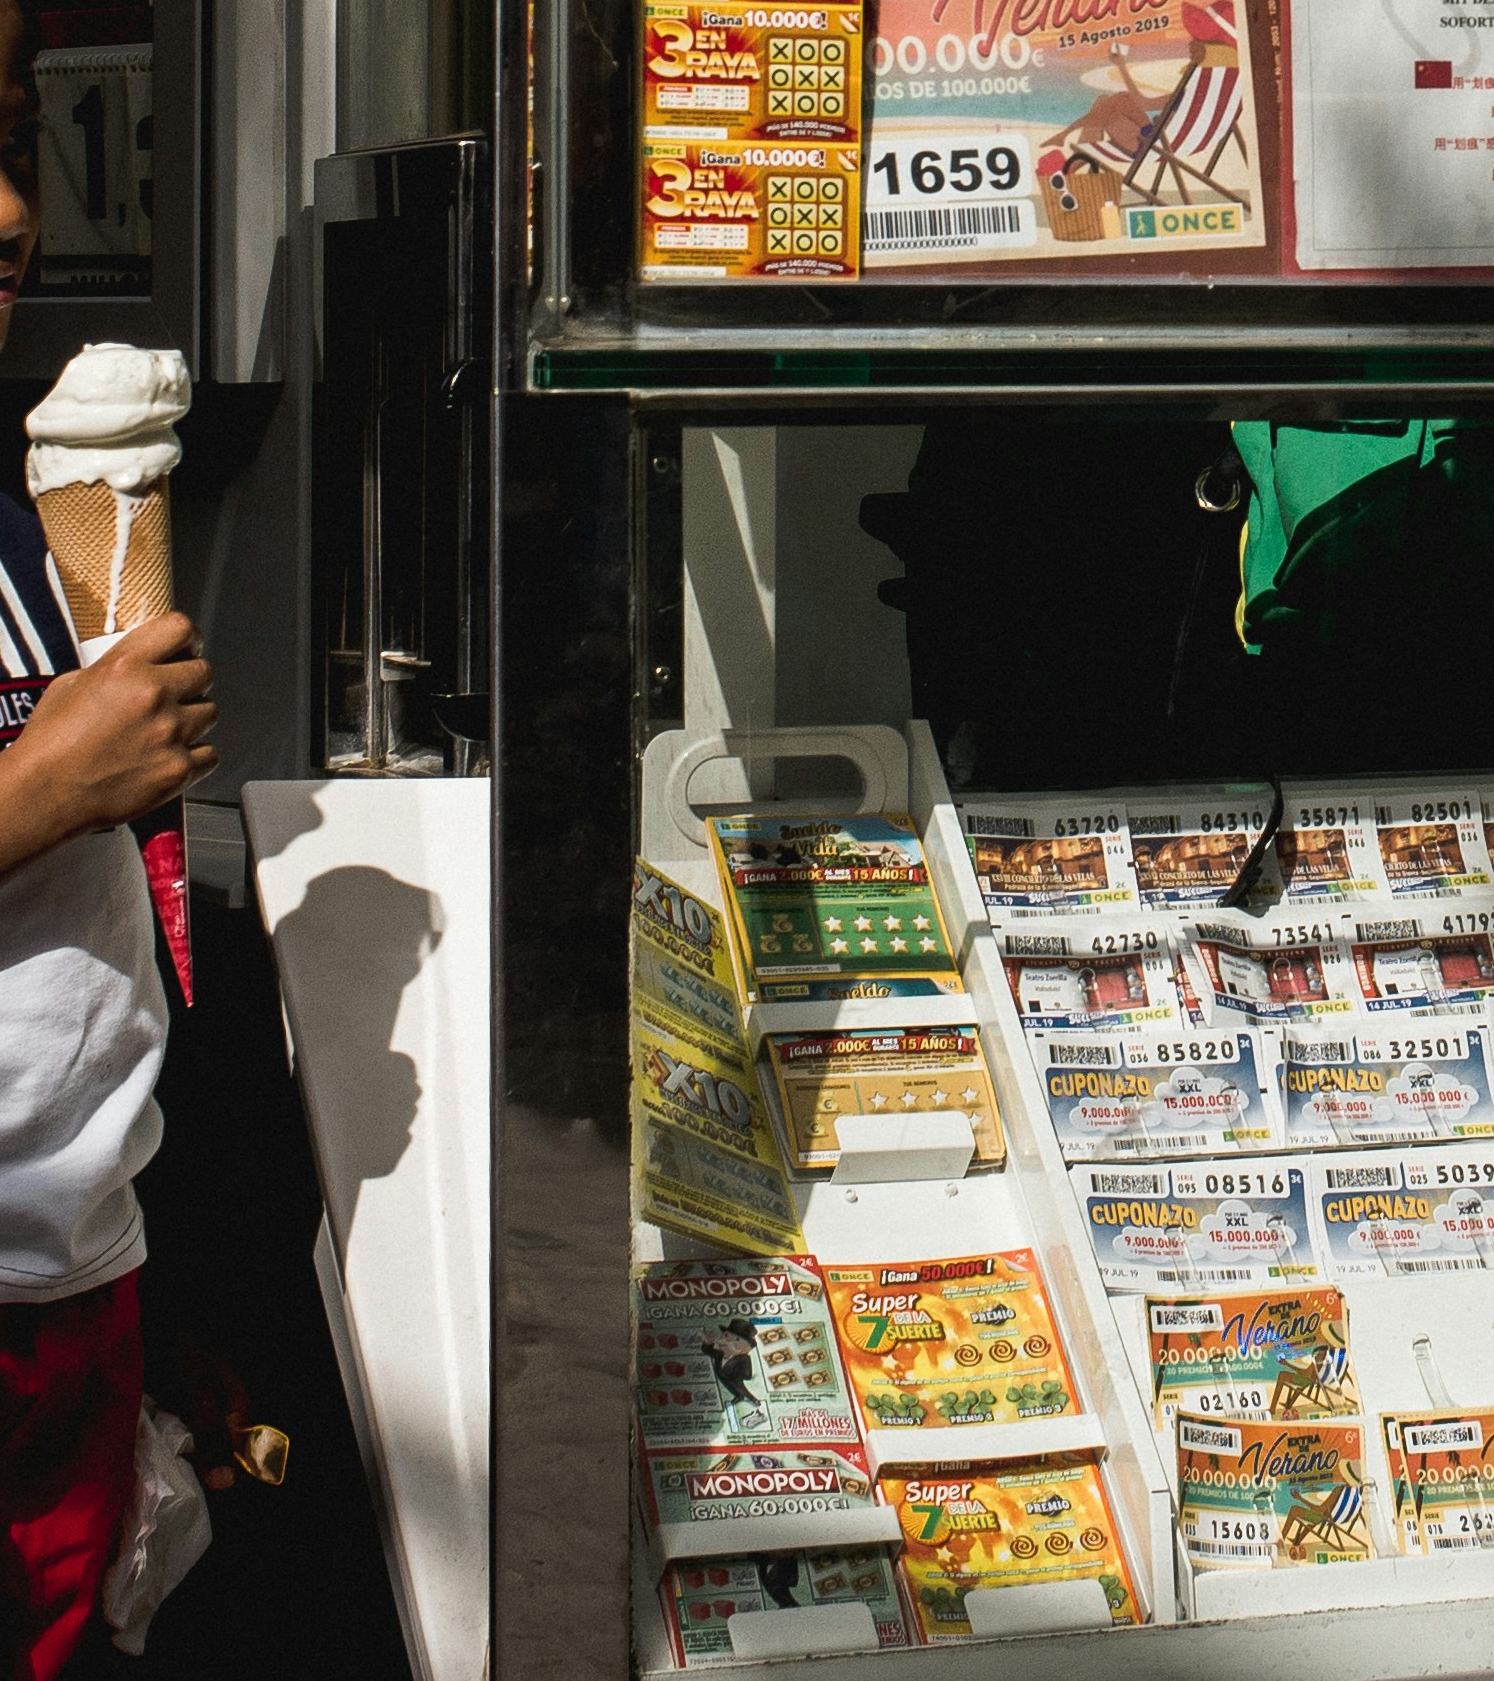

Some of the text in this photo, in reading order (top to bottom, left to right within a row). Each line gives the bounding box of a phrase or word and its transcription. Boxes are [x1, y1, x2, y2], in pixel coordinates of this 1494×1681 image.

[1058, 16, 1170, 49] 15 Agosto 2019
[687, 51, 760, 80] RAYA
[742, 148, 825, 169] 10.000€!
[873, 147, 1022, 196] 1659
[685, 191, 759, 218] RAYA
[1162, 210, 1236, 233] ONCE
[1201, 811, 1264, 832] 84310
[1300, 806, 1360, 828] 35871
[1411, 801, 1473, 823] 82501
[1054, 814, 1119, 836] 63720
[1091, 931, 1158, 955] 42730
[1272, 924, 1335, 946] 73541
[1156, 1039, 1236, 1062] 85820
[1389, 1036, 1464, 1060] 32501
[1049, 1070, 1151, 1098] CUPONAZO
[1288, 1068, 1383, 1094] CUPONAZO
[1205, 1173, 1285, 1195] 08516
[1090, 1201, 1197, 1229] CUPONAZO
[1325, 1195, 1431, 1223] CUPONAZO
[646, 1275, 786, 1299] MONOPOLY
[852, 1292, 918, 1315] Super
[971, 1308, 1016, 1324] PREMIO
[887, 1323, 943, 1340] SUERTE
[1199, 1391, 1262, 1412] 02160
[797, 1417, 851, 1430] MILLONES
[692, 1472, 834, 1497] MONOPOLY
[906, 1482, 972, 1503] Super
[942, 1516, 998, 1532] SUERTE
